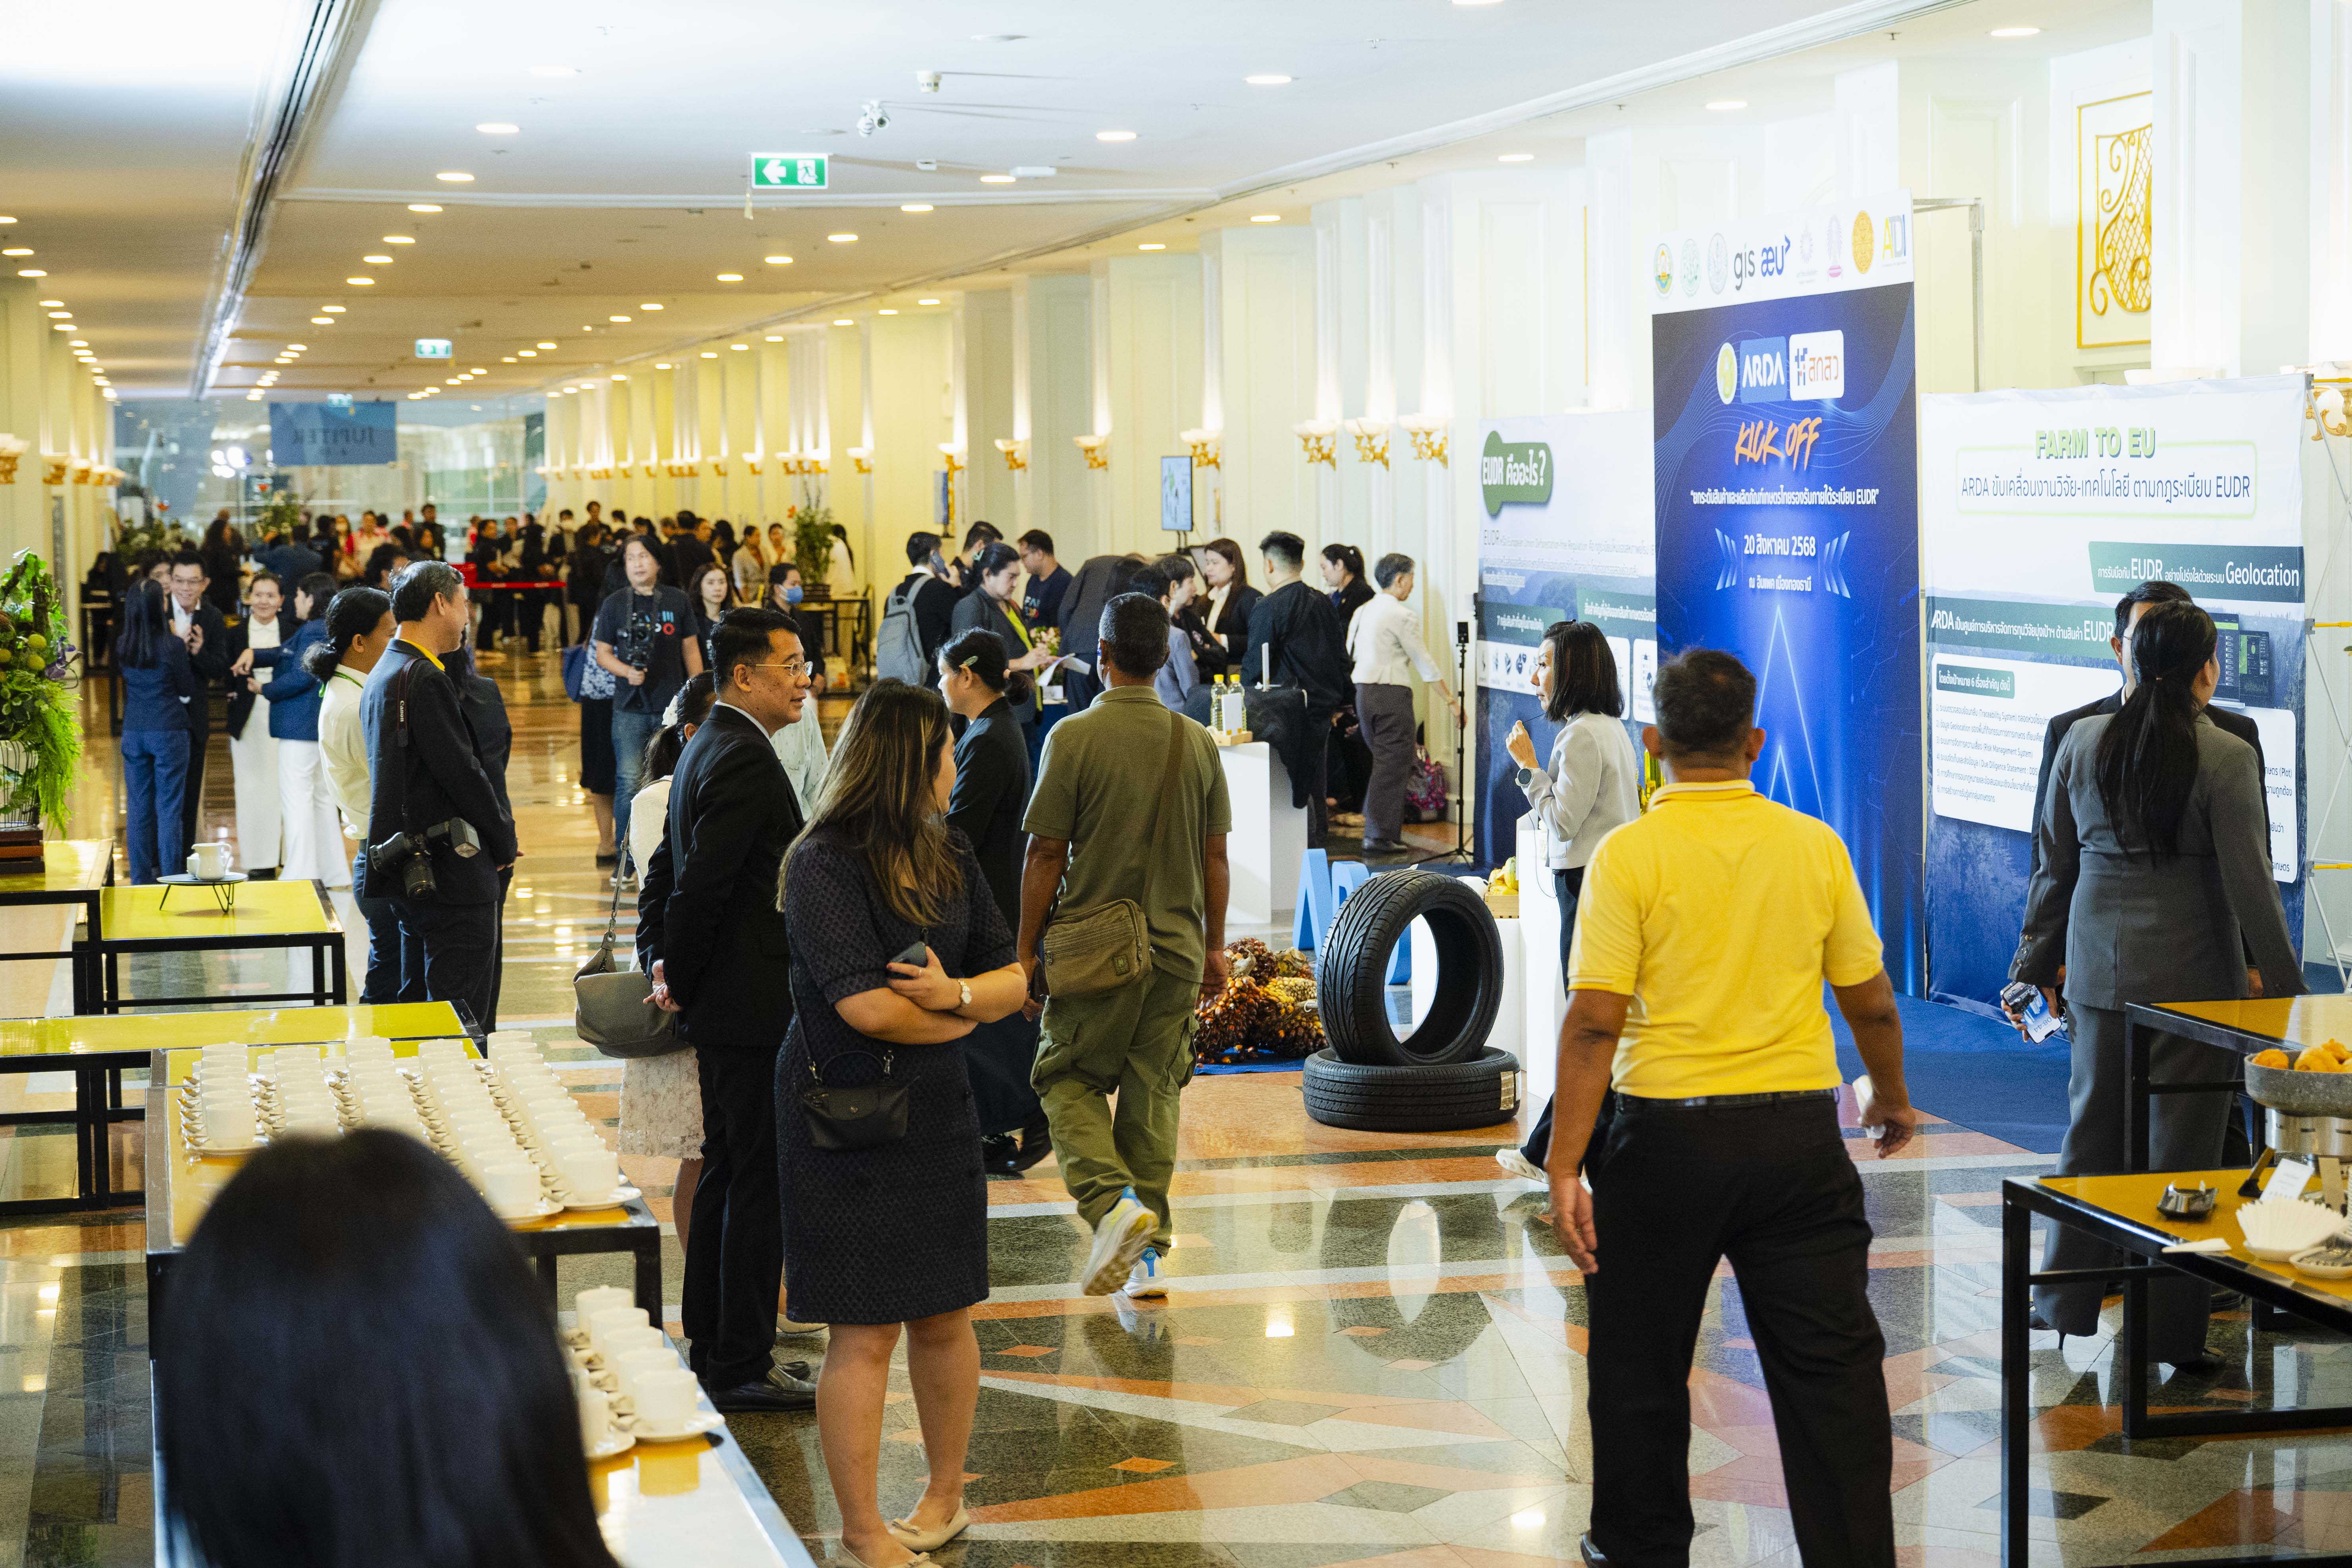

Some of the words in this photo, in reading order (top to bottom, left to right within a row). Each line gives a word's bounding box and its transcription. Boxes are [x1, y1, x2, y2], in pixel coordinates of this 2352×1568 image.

[1742, 351, 1785, 388] ARDA
[1735, 420, 1786, 466] KICK
[1785, 417, 1823, 471] OFF
[2035, 428, 2088, 459] FARM
[2094, 426, 2121, 457] TO
[2129, 427, 2155, 458] EU
[1482, 456, 1504, 485] EUDR
[1962, 477, 1989, 496] ARDA
[1992, 467, 2130, 497] ขับเคลื่อนงานวิจัย-เทคโนโลยี
[2133, 472, 2211, 504] ตามกฎระเบียบ
[2216, 476, 2250, 497] EUDR
[1744, 534, 1755, 554] 20
[1756, 533, 1789, 556] สิงหาคม
[1791, 536, 1816, 556] 2568
[2098, 566, 2130, 580] การรับมือกับ
[2131, 558, 2163, 580] EUDR
[2165, 566, 2224, 583] อย่างโปร่งใสด้วยระบบ
[2225, 561, 2299, 586] Geolocation
[1931, 609, 1955, 630] ARDA
[2056, 625, 2083, 640] ด้านสินค้า
[2084, 620, 2114, 642] EUDR
[1971, 677, 1975, 688] 6
[2279, 767, 2292, 779] (Plot)
[2267, 785, 2292, 798] วามถูกต้อง
[2033, 1016, 2052, 1033] 08:44
